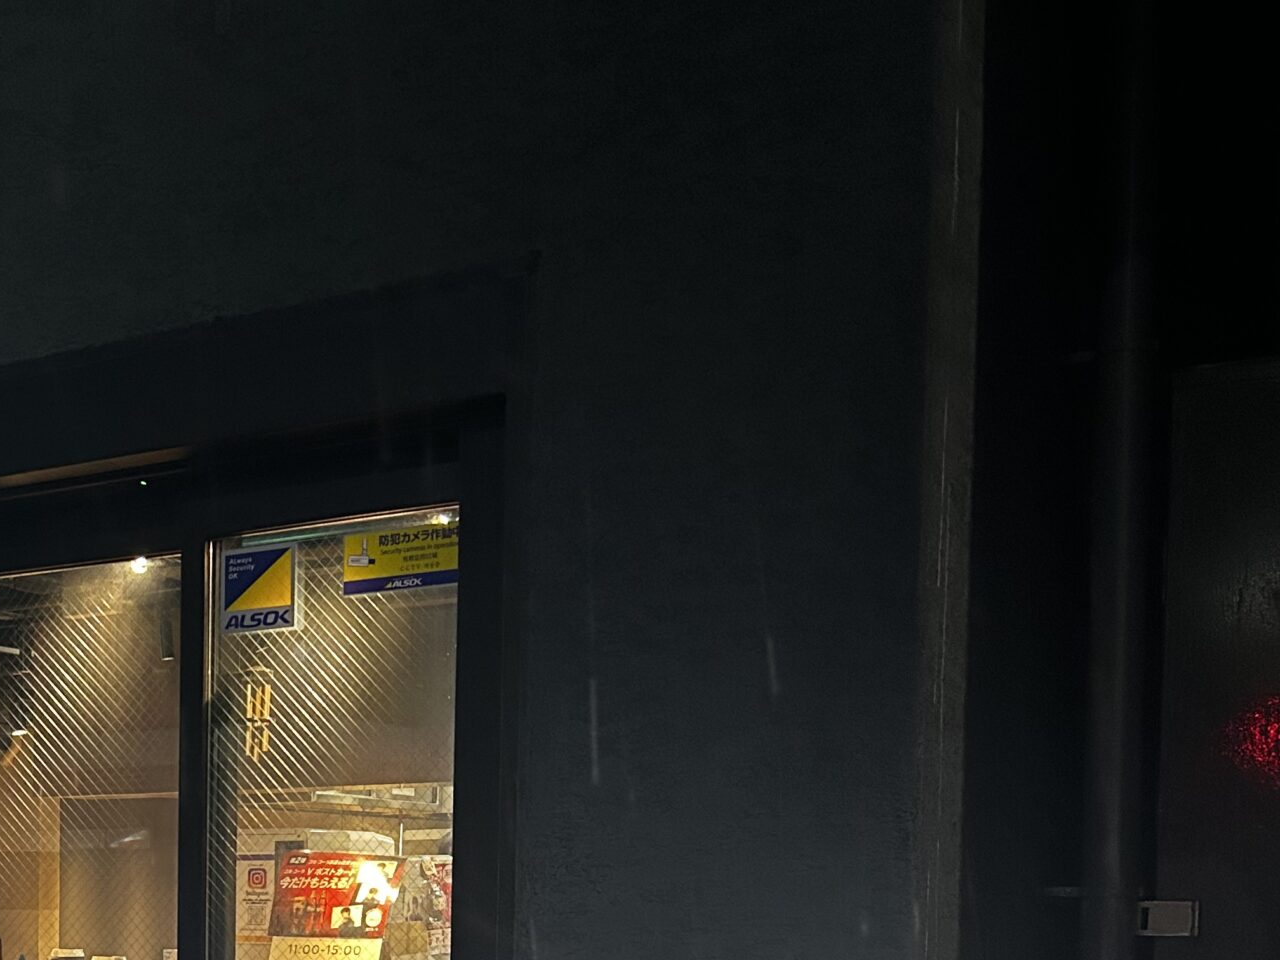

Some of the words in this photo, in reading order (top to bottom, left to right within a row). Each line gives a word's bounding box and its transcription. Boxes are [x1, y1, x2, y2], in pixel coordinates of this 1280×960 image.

[392, 578, 422, 588] ALSOK
[225, 609, 290, 630] ALSOK
[288, 943, 361, 956] 11:00-15:00
